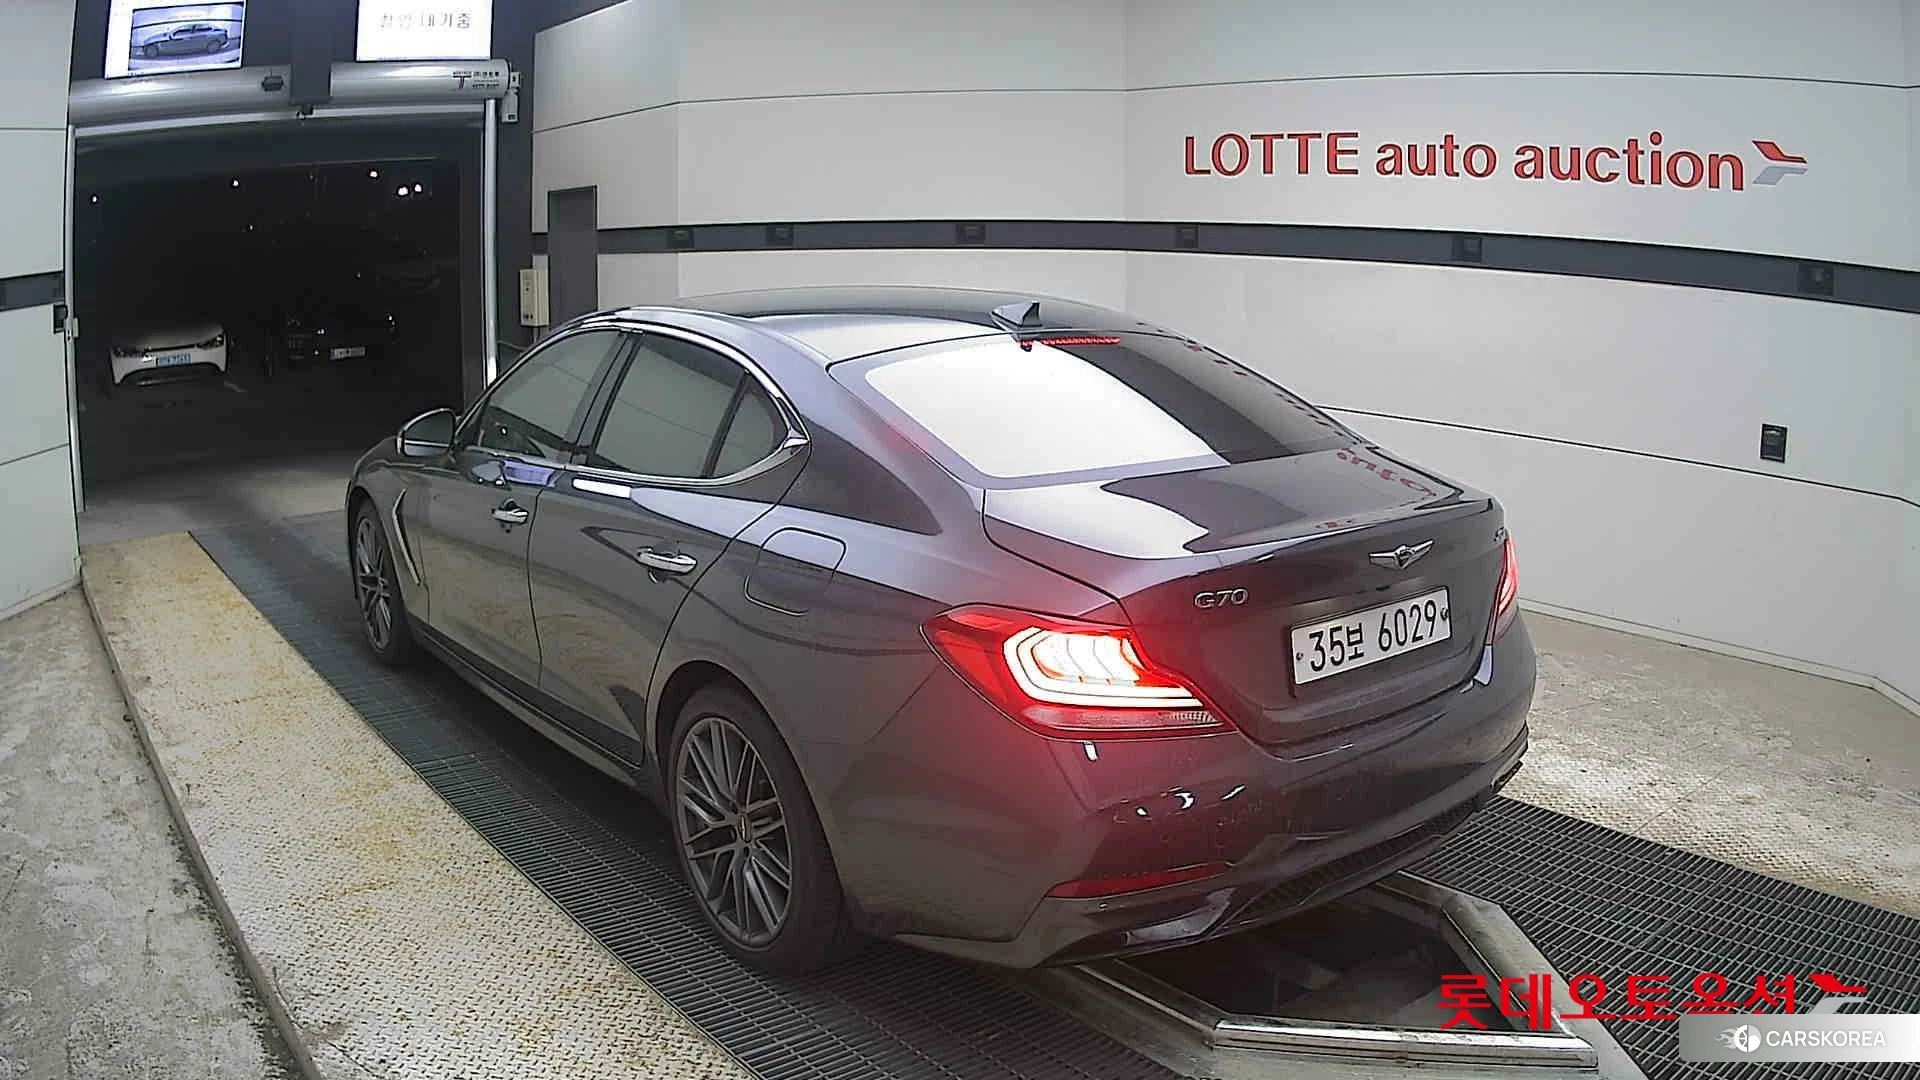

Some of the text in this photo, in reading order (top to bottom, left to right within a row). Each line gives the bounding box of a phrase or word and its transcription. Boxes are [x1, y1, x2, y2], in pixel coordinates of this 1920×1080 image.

[1184, 131, 1744, 191] LOTTE auto auction
[1194, 588, 1248, 608] G70
[1308, 600, 1437, 672] 35보 6029
